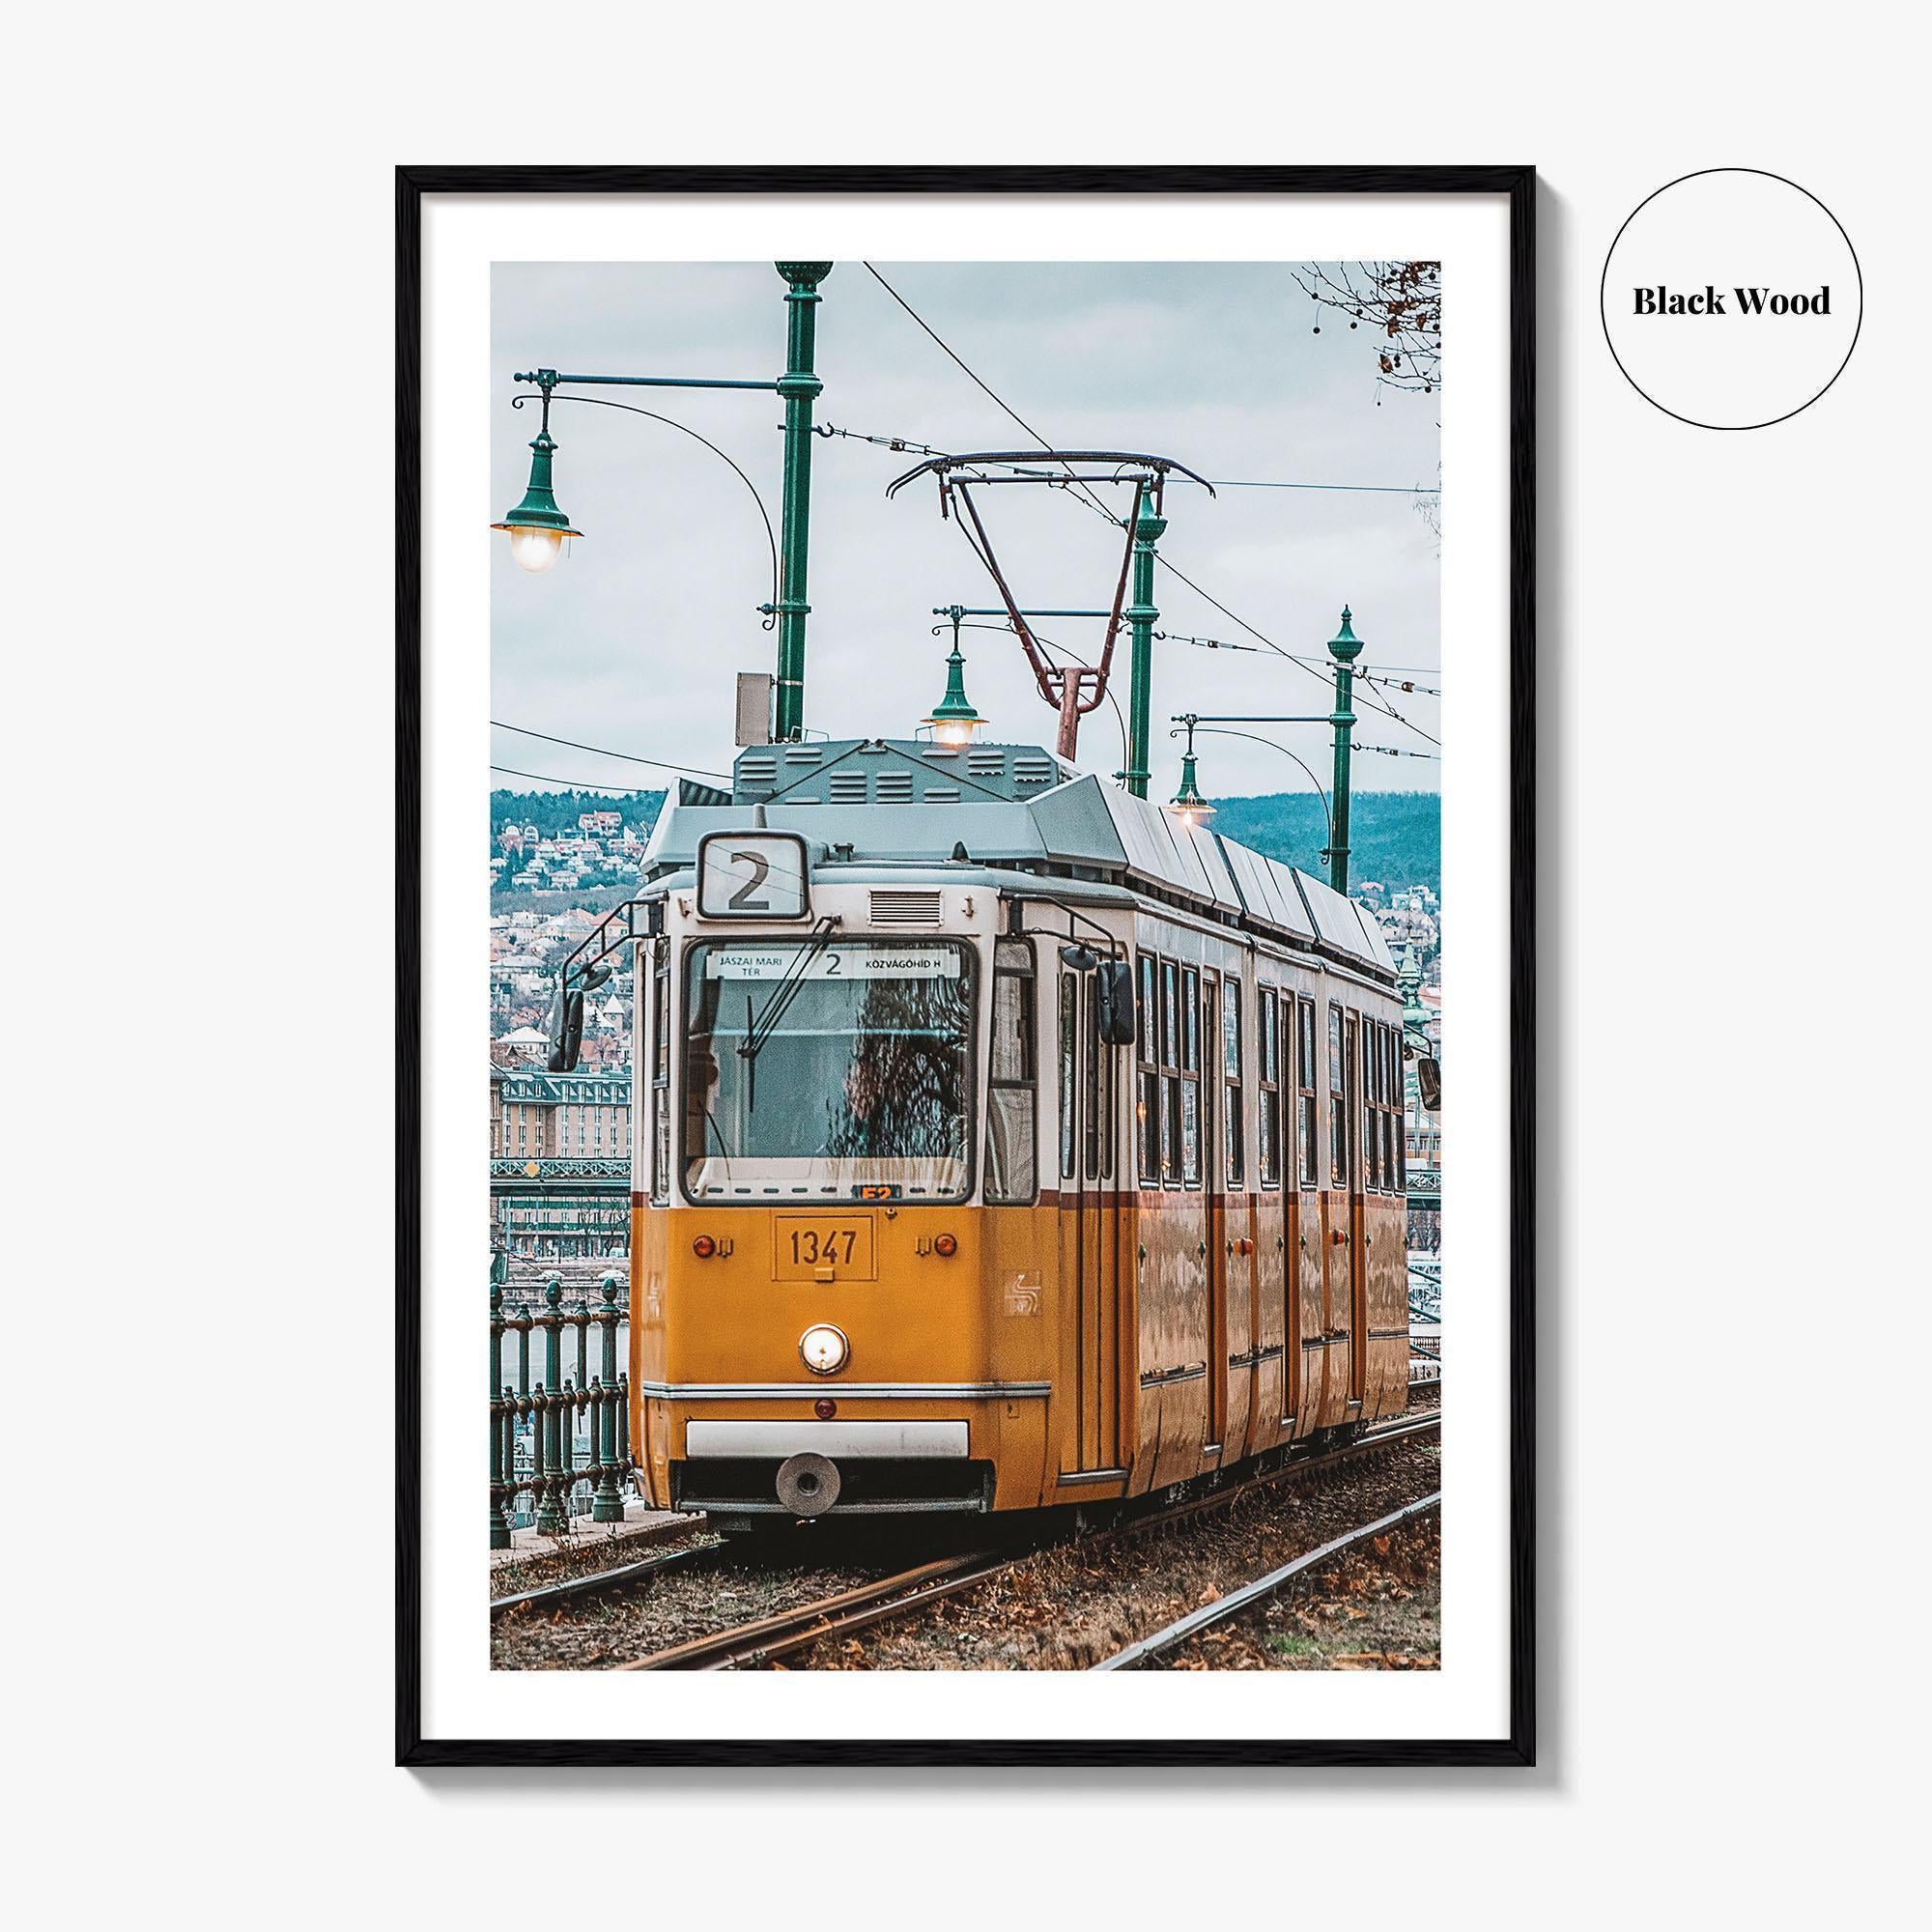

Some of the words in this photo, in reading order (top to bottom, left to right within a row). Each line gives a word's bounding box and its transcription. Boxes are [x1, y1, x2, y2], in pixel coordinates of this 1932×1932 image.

[728, 850, 770, 910] 2
[755, 956, 782, 966] MARI
[826, 952, 841, 976] 2
[790, 1230, 857, 1264] 1347
